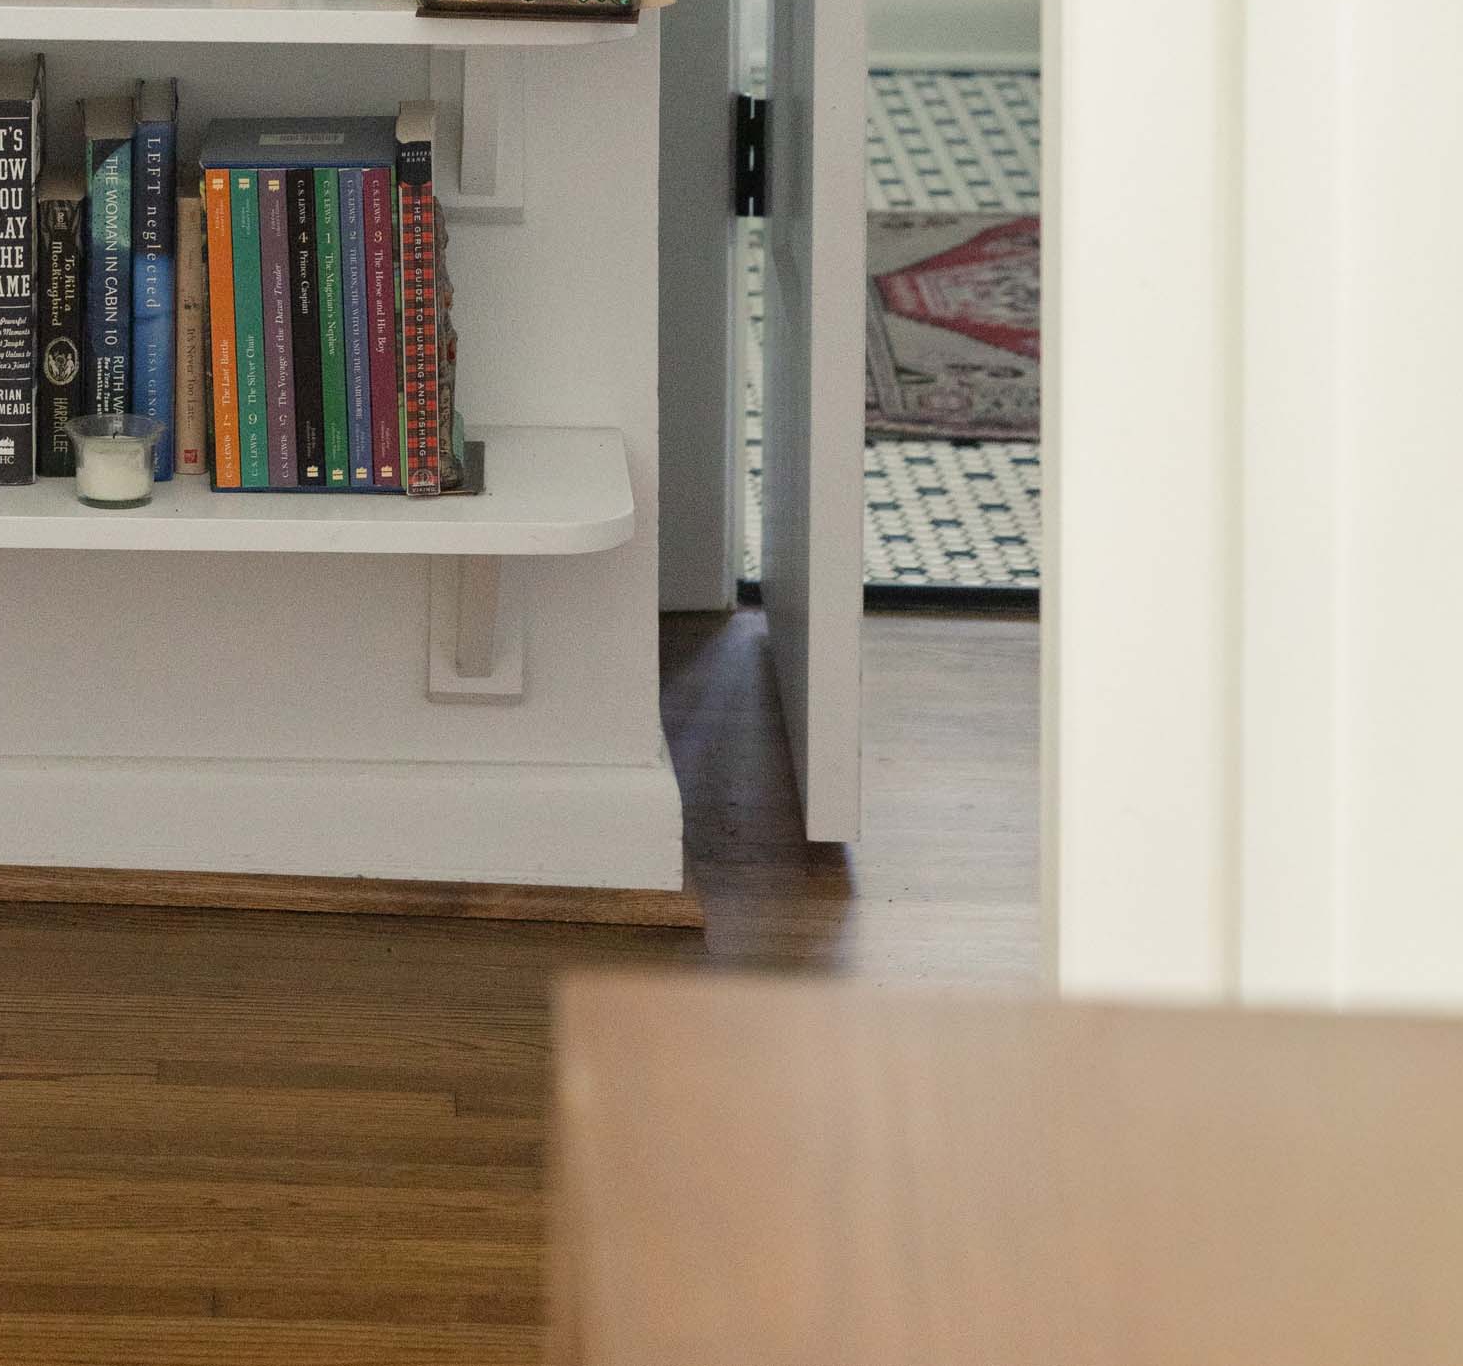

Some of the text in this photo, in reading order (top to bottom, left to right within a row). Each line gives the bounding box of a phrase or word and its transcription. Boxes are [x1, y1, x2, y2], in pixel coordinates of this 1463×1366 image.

[142, 138, 161, 307] LEFT neglected
[298, 198, 307, 224] LEWIS
[105, 156, 119, 346] THE WOMAN IN CABIN 10
[47, 242, 63, 326] Mockingbird
[65, 255, 75, 299] To Kill
[299, 251, 311, 314] Prince Caspian
[415, 268, 423, 302] GUIDE
[0, 316, 27, 327] Powerful
[324, 252, 337, 356] The Magician's Nephew
[374, 250, 388, 354] The Horse and Boy
[416, 308, 424, 322] TO
[3, 328, 31, 336] Moments
[3, 339, 25, 348] Taught
[273, 264, 288, 405] The Voyage Dawn Treader
[417, 327, 425, 378] HUNTING
[113, 355, 125, 391] RUTH
[187, 347, 196, 374] Never
[220, 339, 231, 405] The Battle
[246, 334, 257, 405] The Silver Chair
[54, 434, 68, 453] LEE
[418, 410, 426, 457] FISHING
[0, 456, 15, 464] HC
